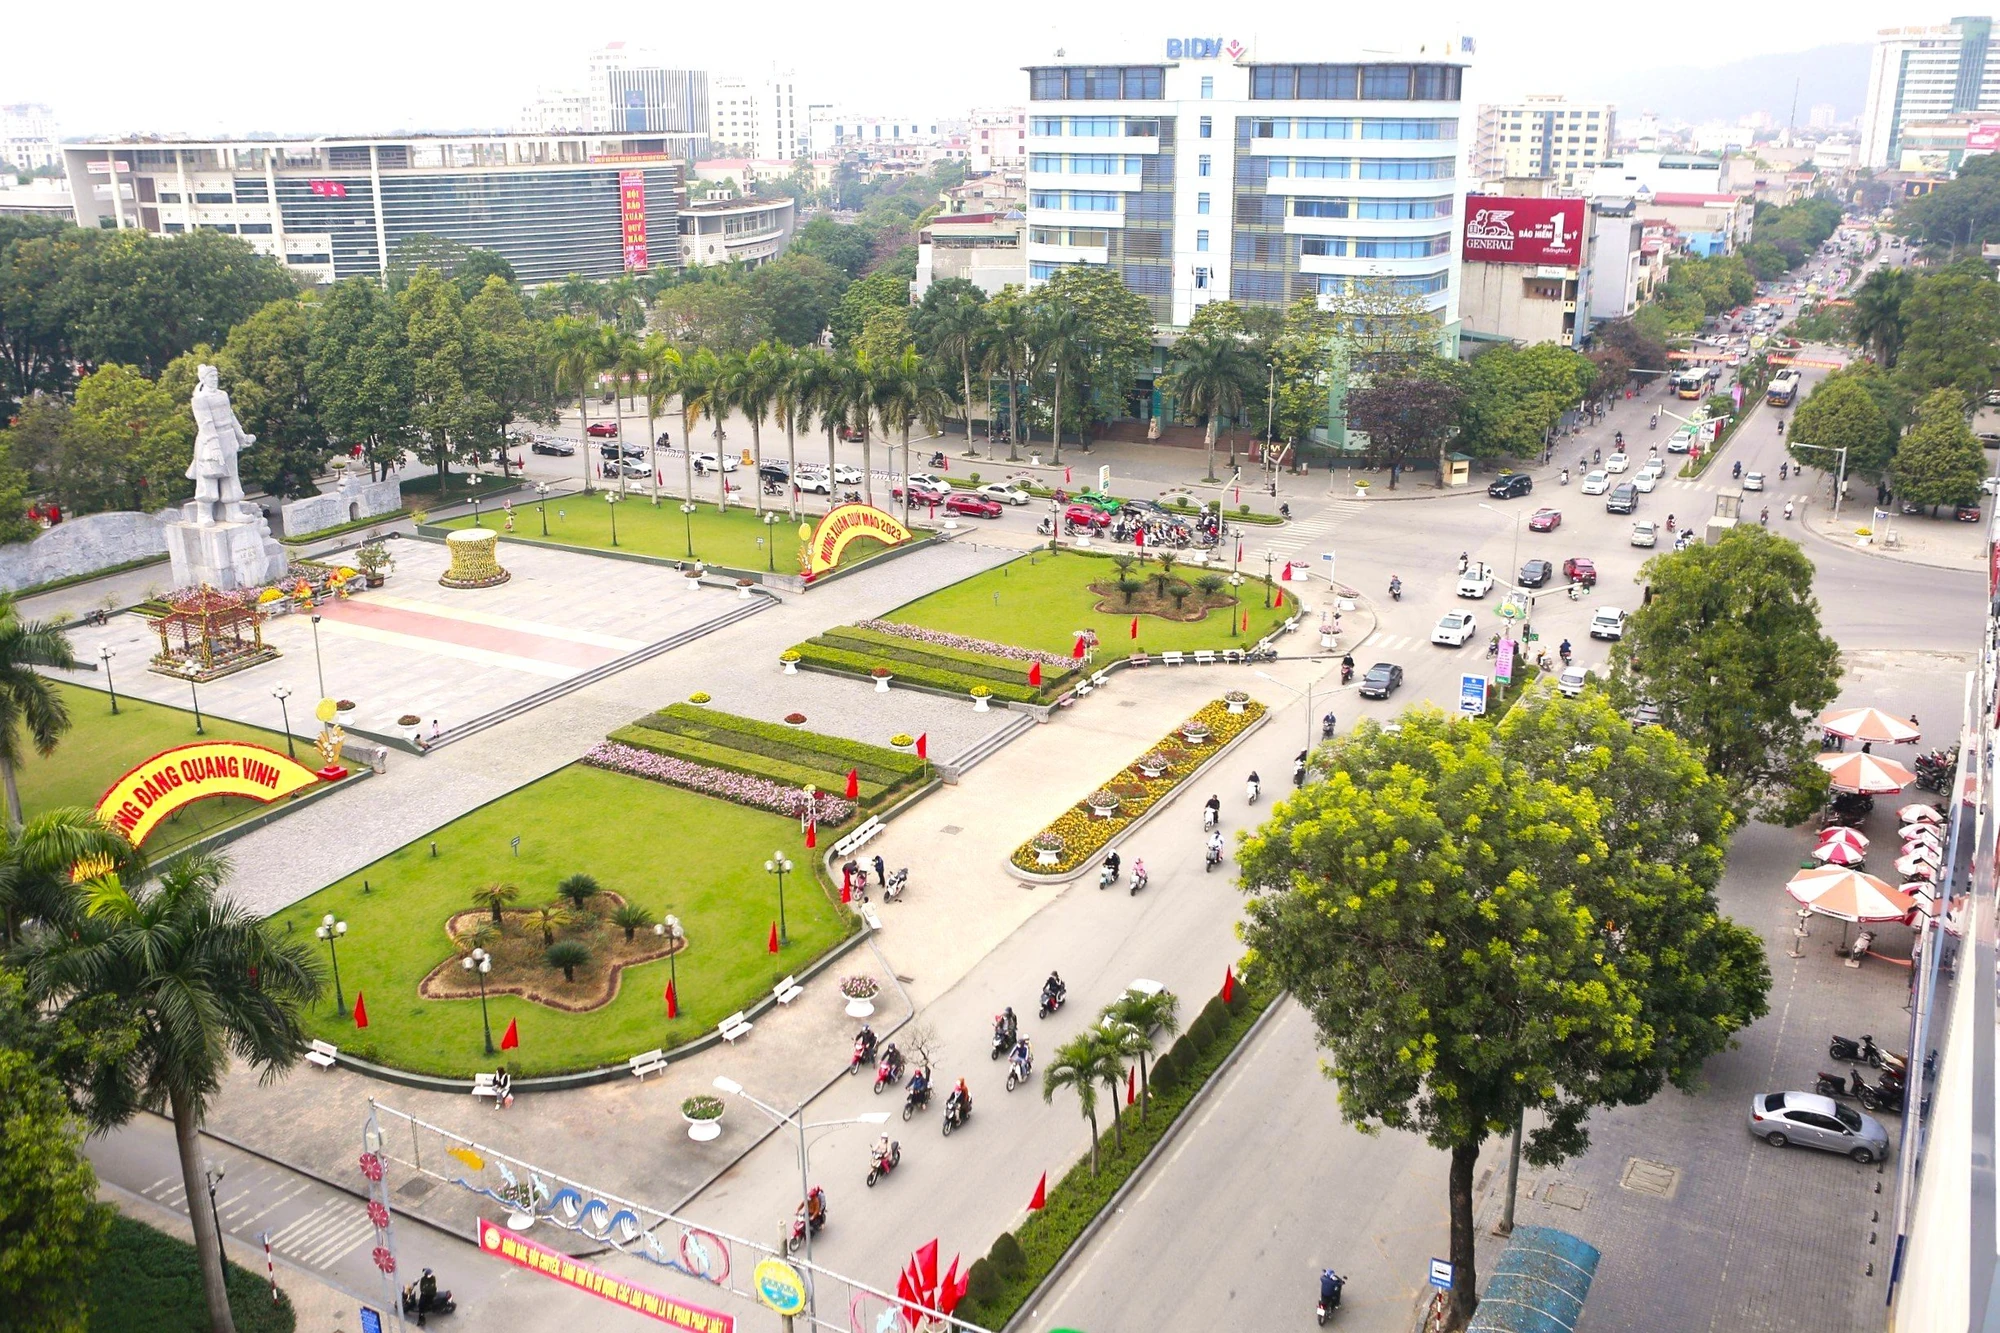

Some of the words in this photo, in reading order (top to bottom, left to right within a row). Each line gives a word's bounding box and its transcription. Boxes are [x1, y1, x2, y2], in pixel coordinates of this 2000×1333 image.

[1167, 37, 1223, 59] BIDV
[626, 188, 639, 199] HỘI
[625, 211, 644, 221] XUÂN
[628, 223, 642, 233] QUÝ
[1534, 228, 1553, 239] HIỂM
[1550, 212, 1566, 247] 1
[628, 234, 643, 243] MÃO
[1466, 239, 1514, 250] GENERALI
[829, 515, 850, 539] XUÂN
[847, 509, 862, 528] QUÝ
[862, 511, 880, 530] MÃO
[881, 519, 902, 541] 2023
[132, 765, 183, 807] ĐẢNG
[180, 756, 239, 784] QUANG
[242, 757, 281, 790] VINH
[617, 1281, 631, 1304] CÁC
[629, 1287, 643, 1311] LOẠI
[642, 1293, 659, 1315] PHÁO
[658, 1297, 667, 1318] LÀ
[666, 1303, 675, 1321] VI
[673, 1305, 692, 1328] PHẠM
[691, 1311, 708, 1331] PHÁP
